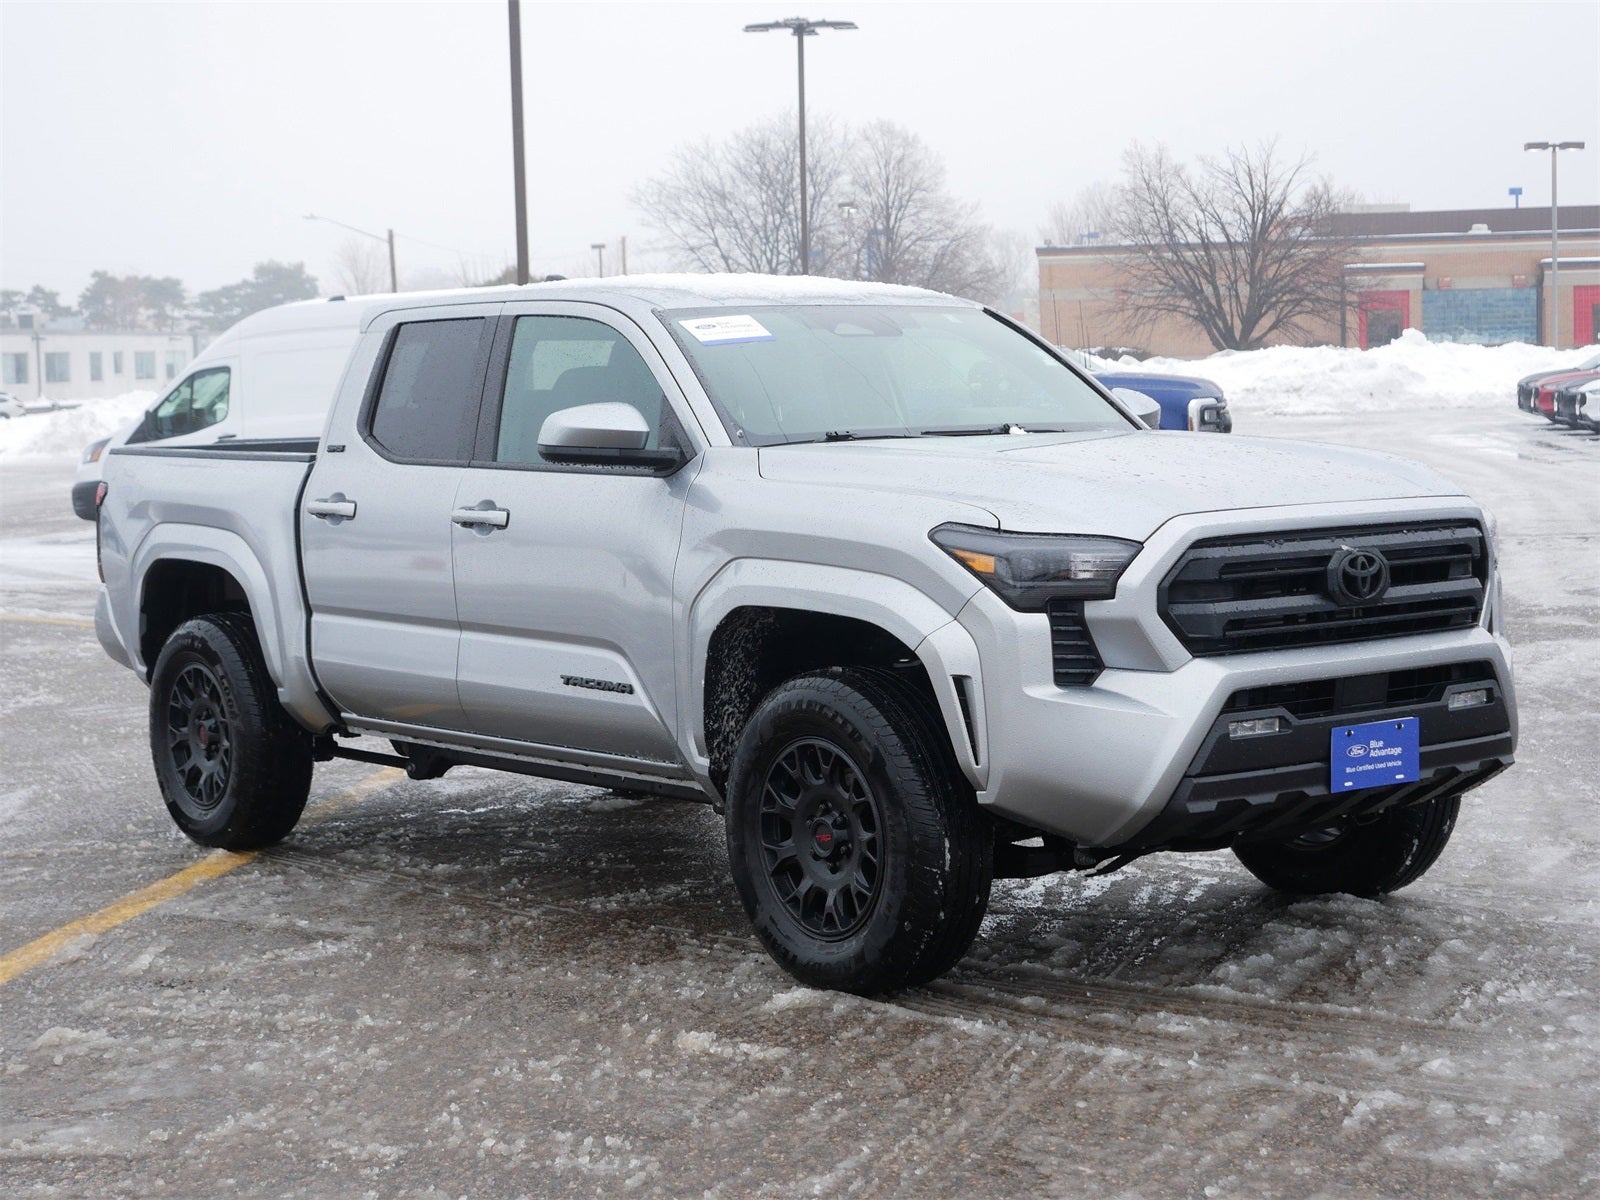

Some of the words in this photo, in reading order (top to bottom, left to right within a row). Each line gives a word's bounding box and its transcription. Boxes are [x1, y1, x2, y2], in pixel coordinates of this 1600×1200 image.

[560, 674, 634, 695] TACOMA
[1370, 741, 1383, 749] Blue
[1348, 745, 1367, 757] Ford
[1370, 747, 1402, 757] Advantage
